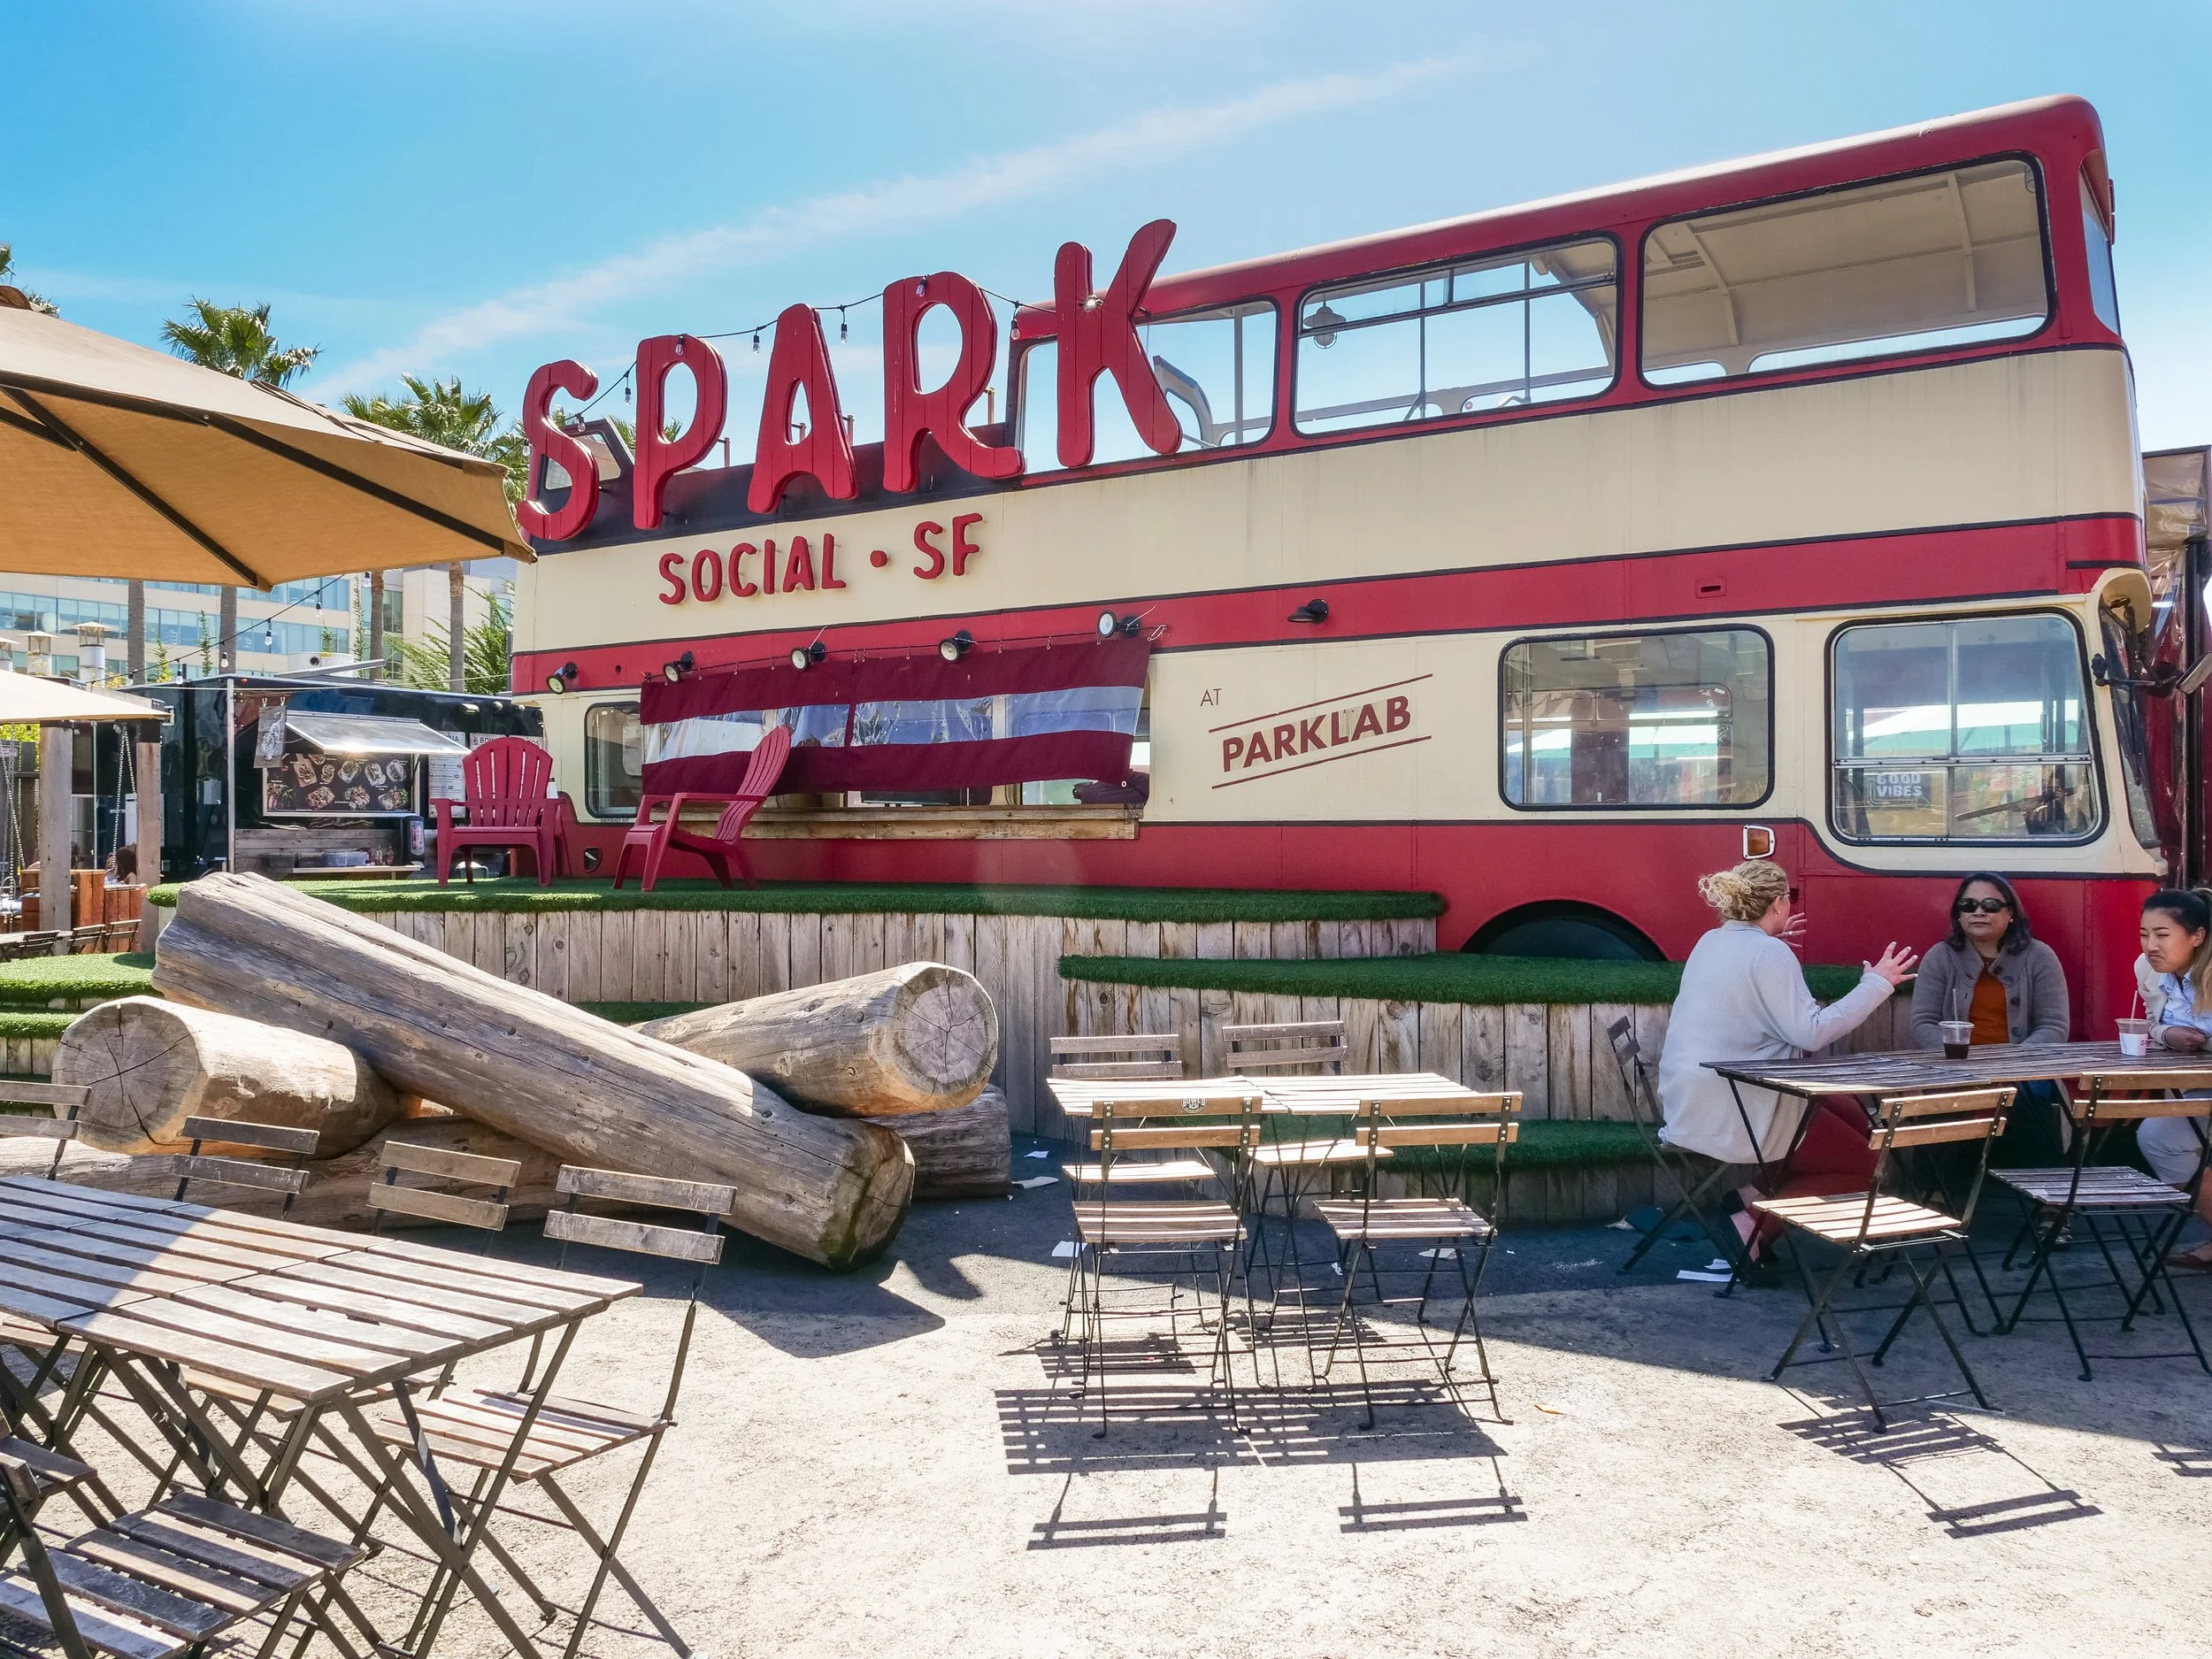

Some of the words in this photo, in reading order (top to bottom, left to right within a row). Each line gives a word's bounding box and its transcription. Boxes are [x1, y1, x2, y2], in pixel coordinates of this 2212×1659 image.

[517, 218, 1182, 541] SPARK
[659, 533, 847, 605] SOCIAL
[913, 512, 983, 580] SF
[1200, 688, 1222, 707] AT
[1223, 695, 1411, 772] PARKLAB
[1877, 772, 1922, 785] GOOD
[1877, 785, 1923, 797] VIBES
